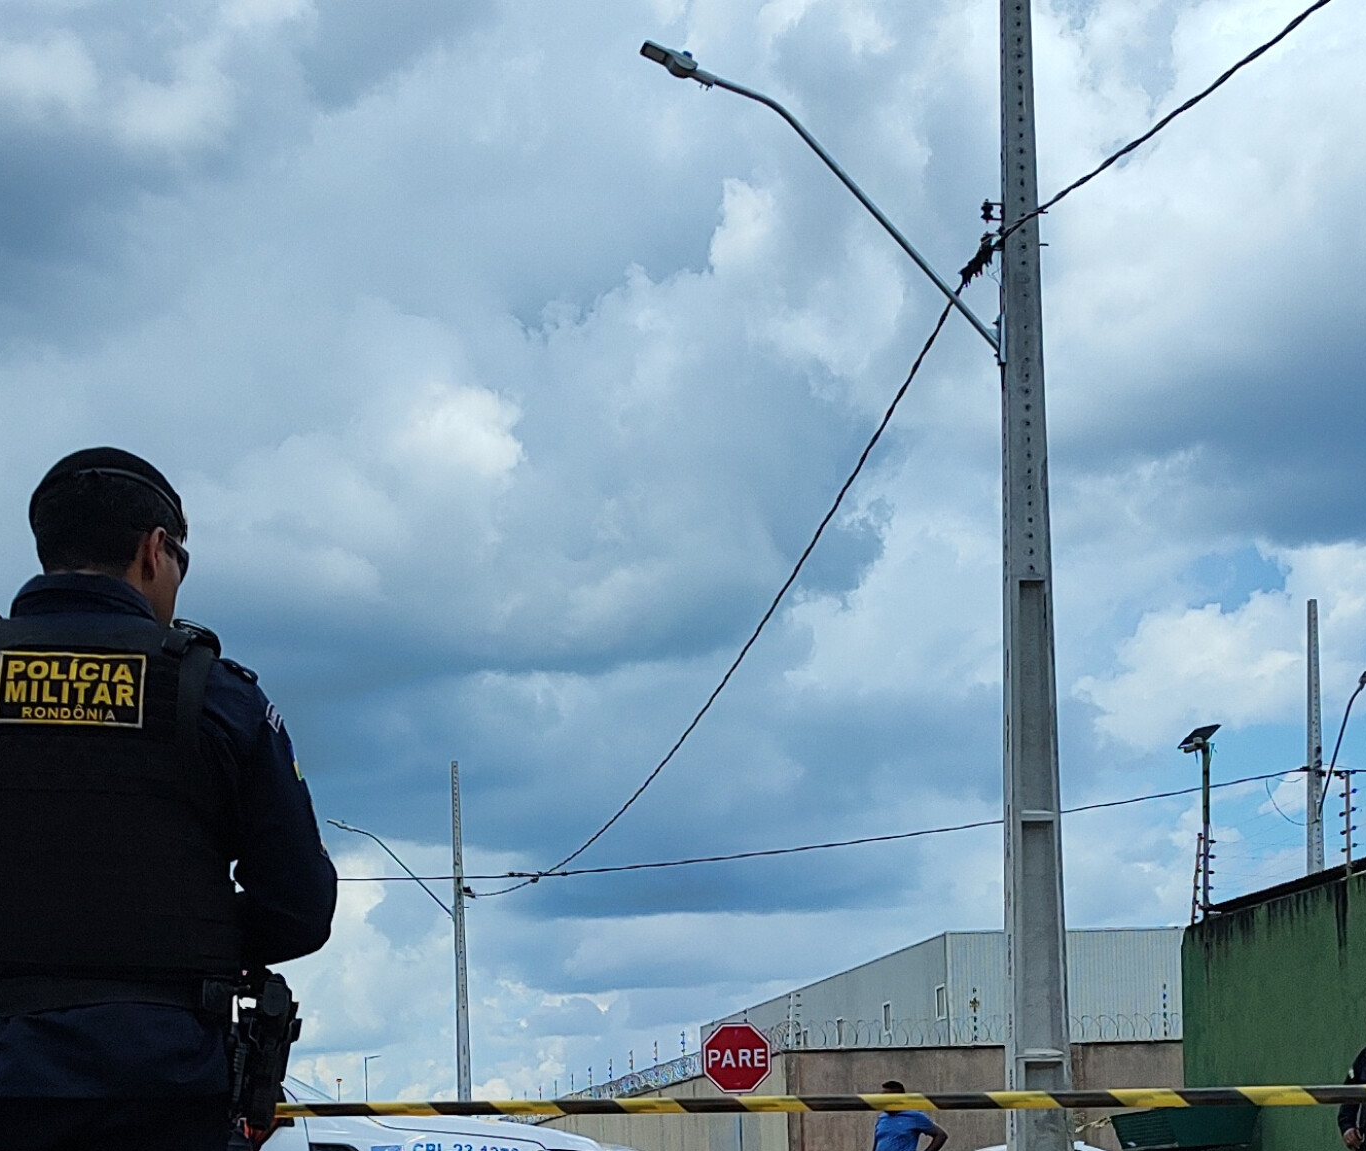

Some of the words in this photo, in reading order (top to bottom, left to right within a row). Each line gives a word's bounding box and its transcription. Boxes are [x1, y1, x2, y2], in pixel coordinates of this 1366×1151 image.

[6, 658, 135, 683] POLÍCIA
[4, 680, 135, 707] MILITAR
[21, 704, 116, 721] RONDÔNIA
[708, 1048, 766, 1069] PARE
